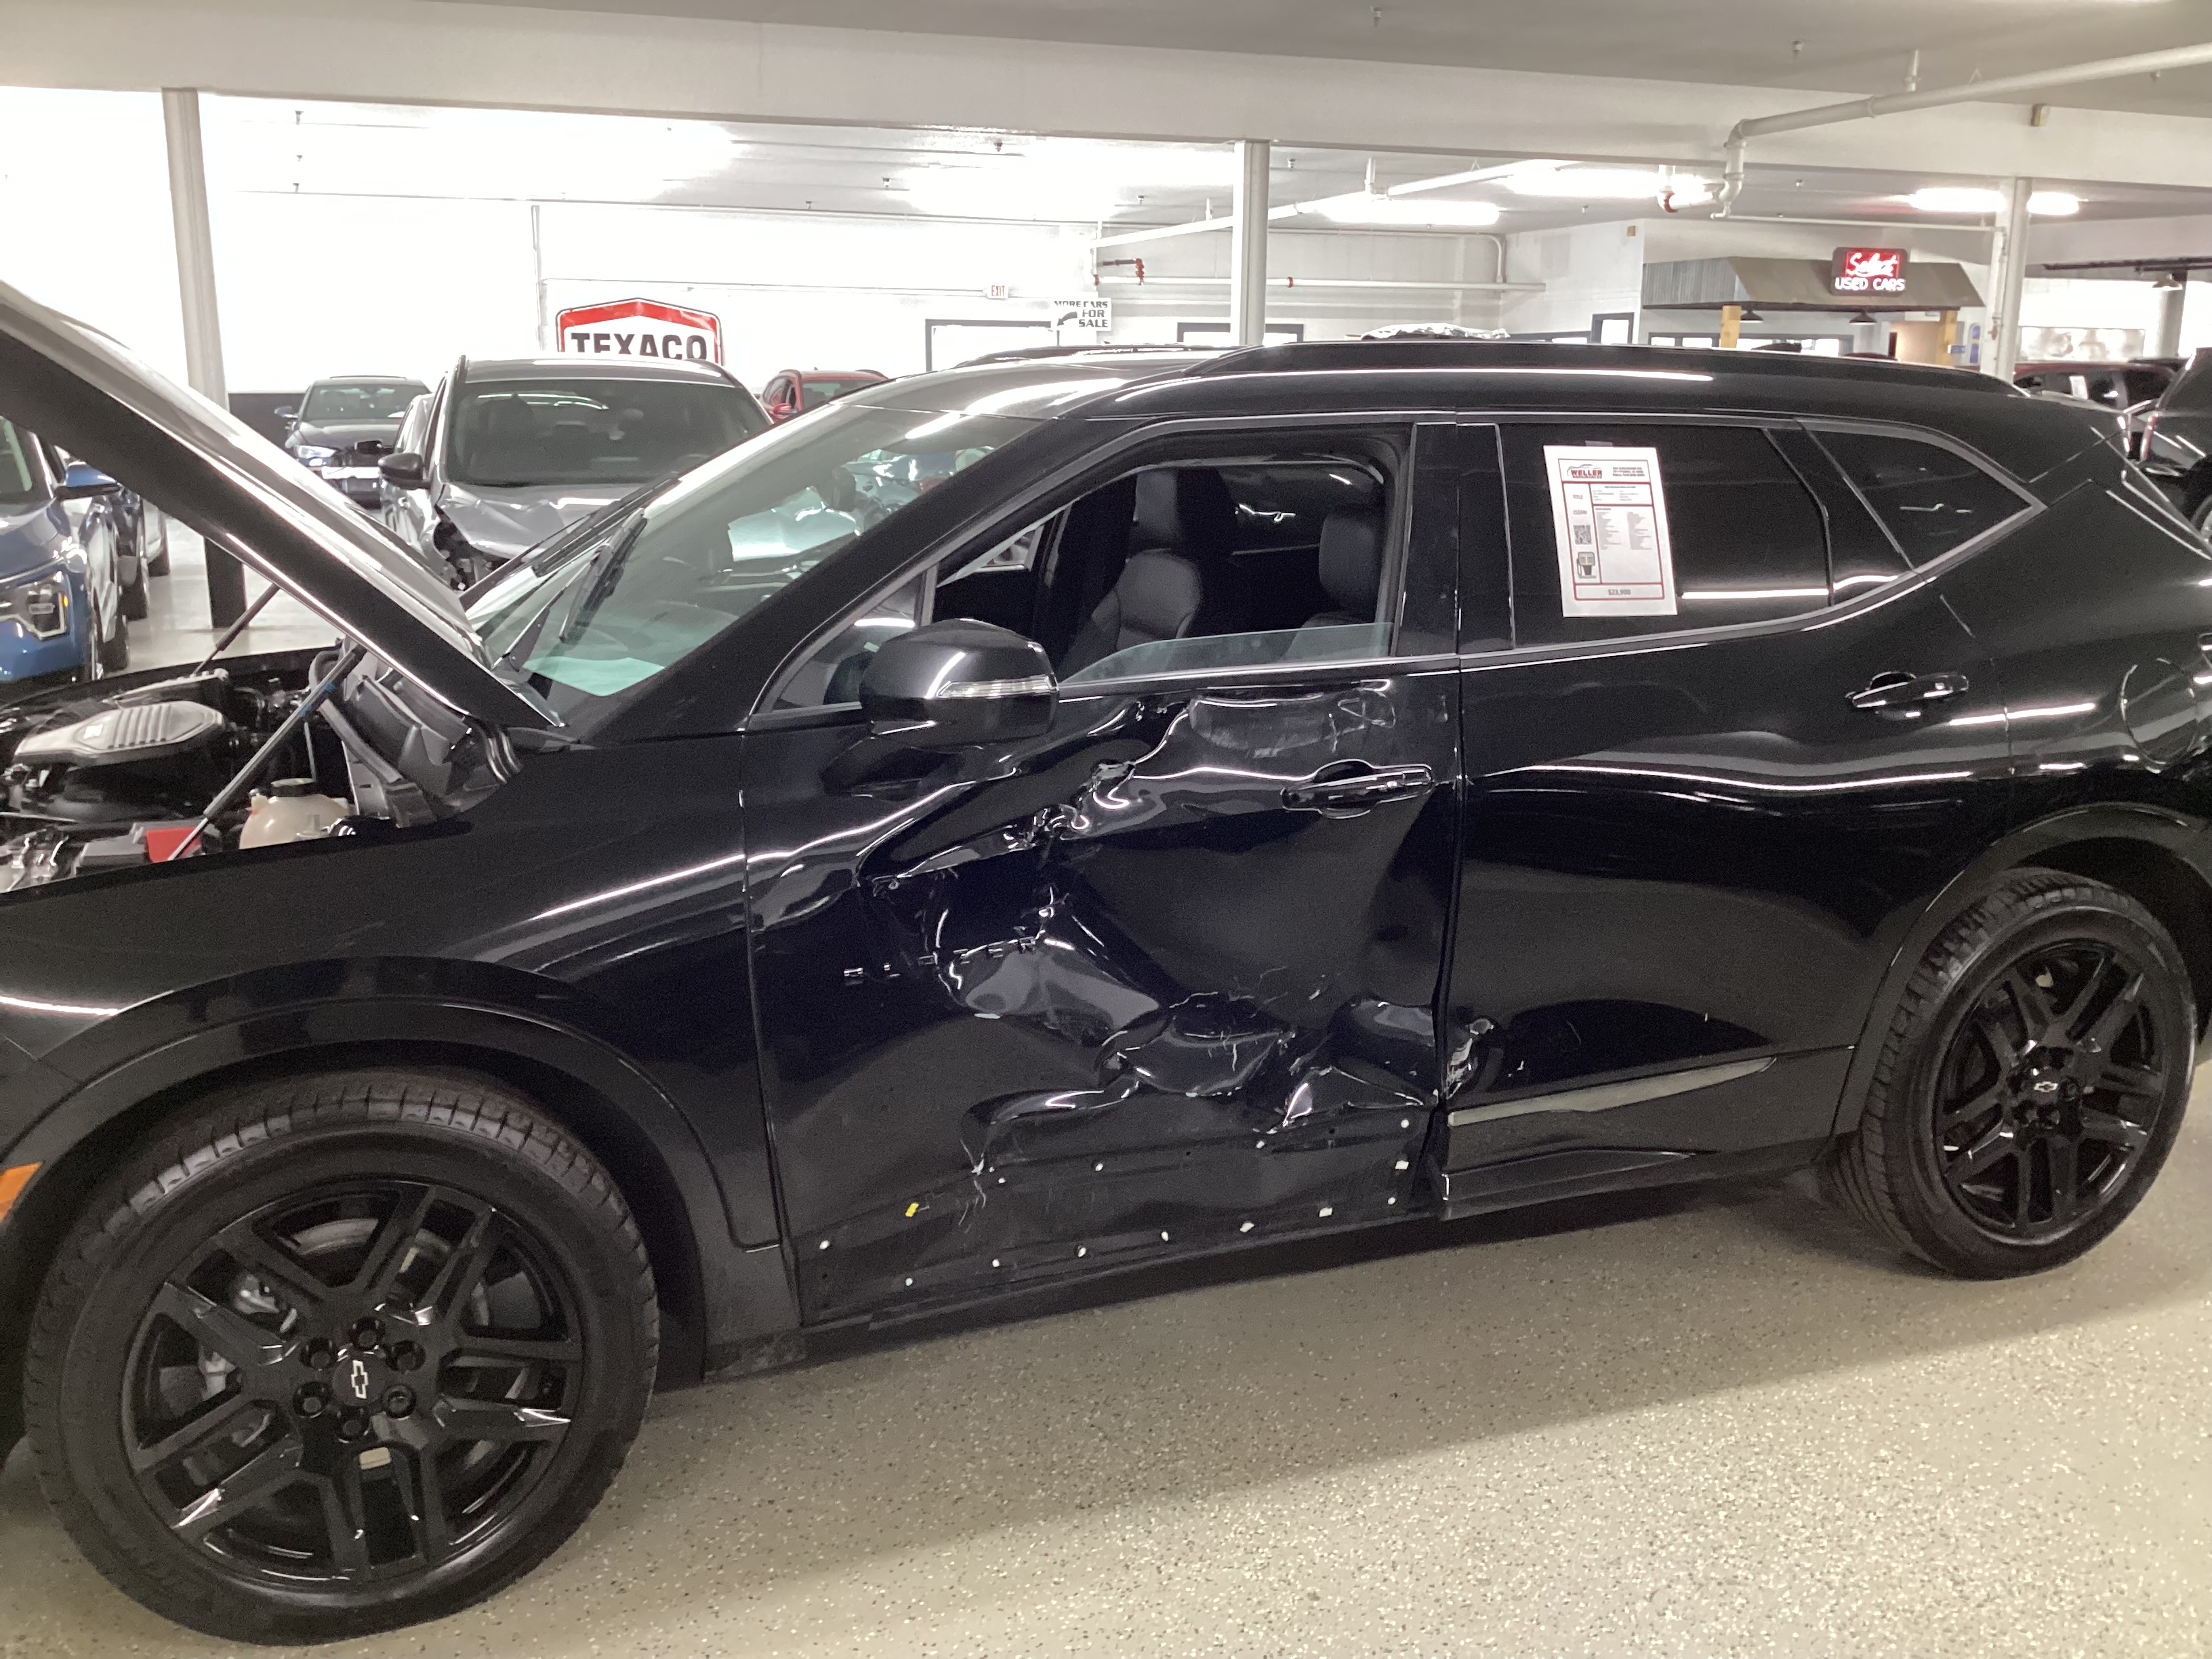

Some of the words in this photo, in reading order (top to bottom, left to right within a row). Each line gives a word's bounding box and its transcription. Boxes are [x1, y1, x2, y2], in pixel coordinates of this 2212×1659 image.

[1846, 252, 1898, 277] Select
[1835, 277, 1868, 290] USED
[1872, 278, 1906, 291] CARS
[991, 285, 1006, 297] EXIT
[1082, 309, 1105, 318] FOR
[1078, 319, 1109, 328] SALE
[571, 332, 707, 361] TEXACO
